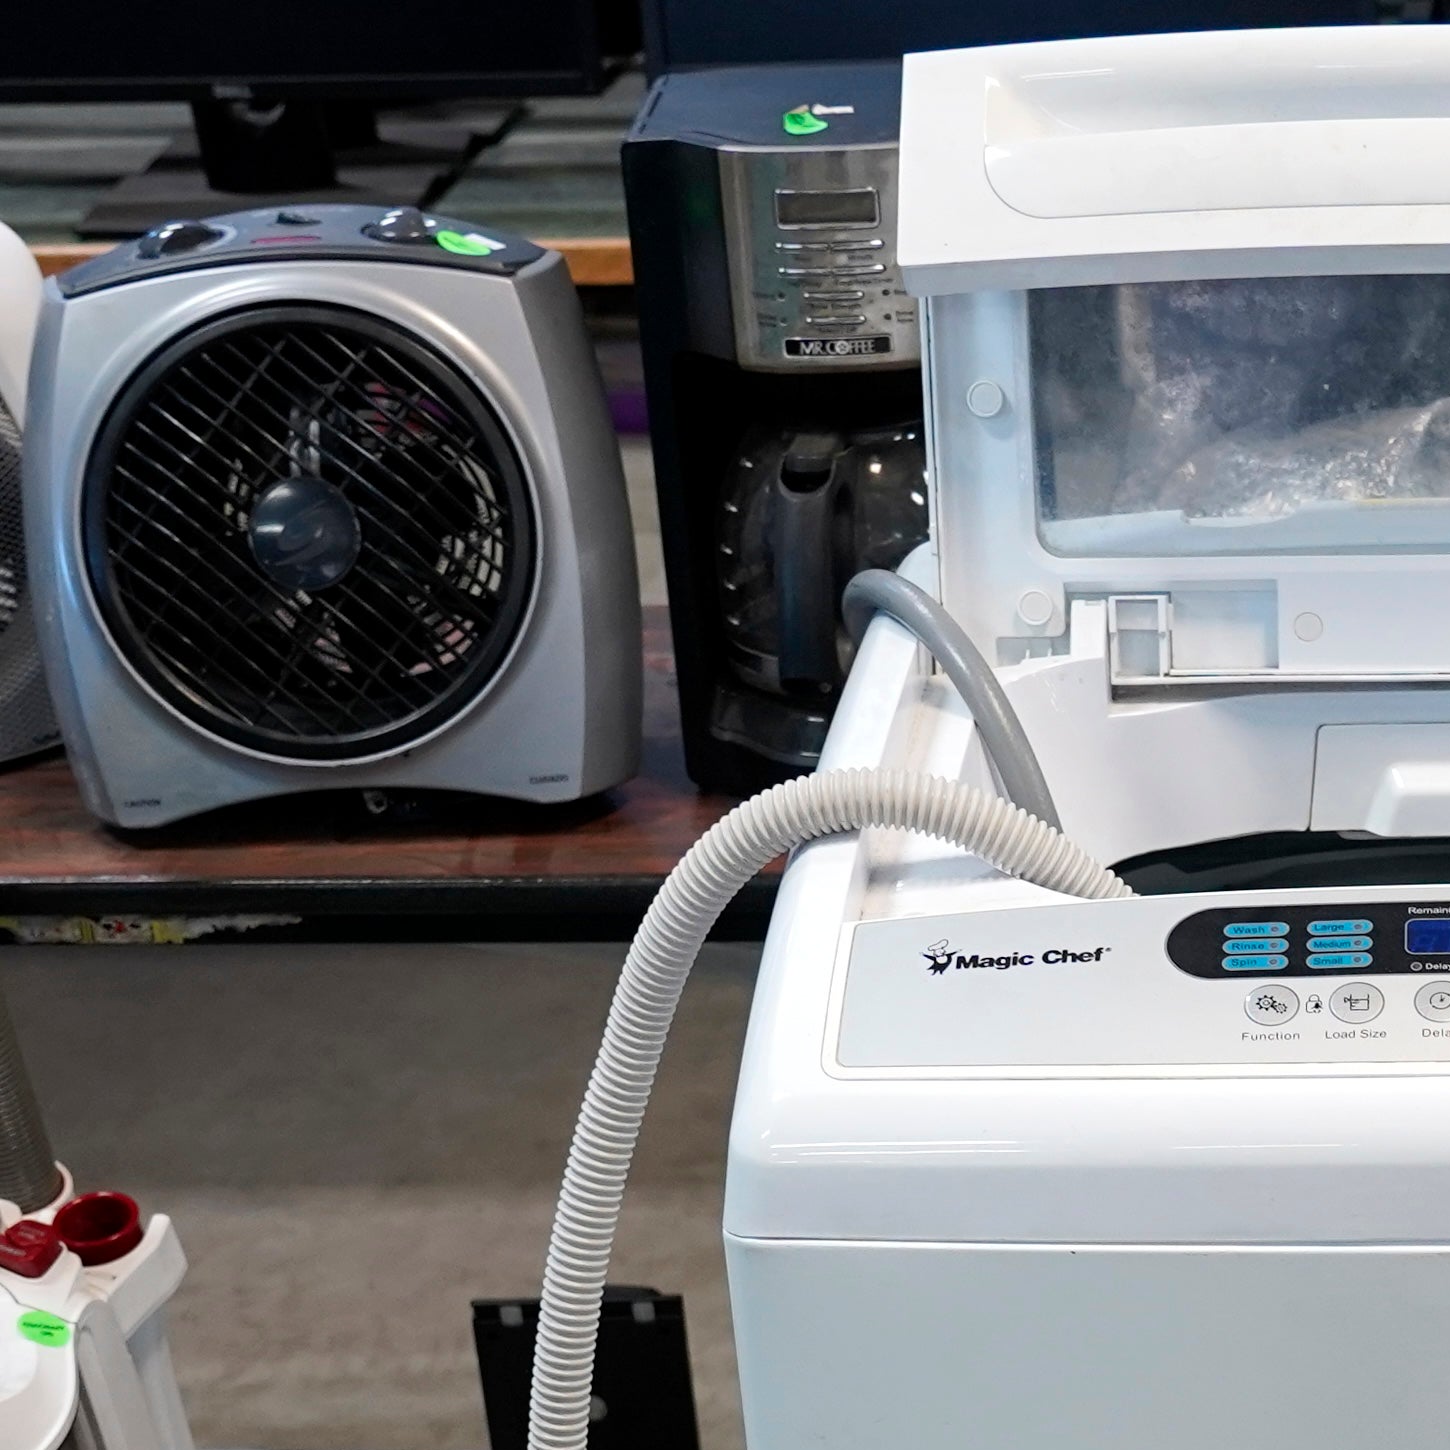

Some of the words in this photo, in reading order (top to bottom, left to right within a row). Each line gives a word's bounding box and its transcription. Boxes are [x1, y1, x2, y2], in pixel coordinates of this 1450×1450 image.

[1233, 926, 1265, 934] Wash
[1314, 923, 1344, 932] Large
[1231, 942, 1265, 950] Rinse
[1313, 940, 1351, 949] Medium
[955, 952, 1035, 970] Magic
[1041, 947, 1105, 964] Chef
[1231, 958, 1257, 967] Spin
[1313, 957, 1343, 965] Small
[1241, 1031, 1301, 1041] Function
[1325, 1030, 1356, 1040] Load
[1359, 1029, 1388, 1039] Size
